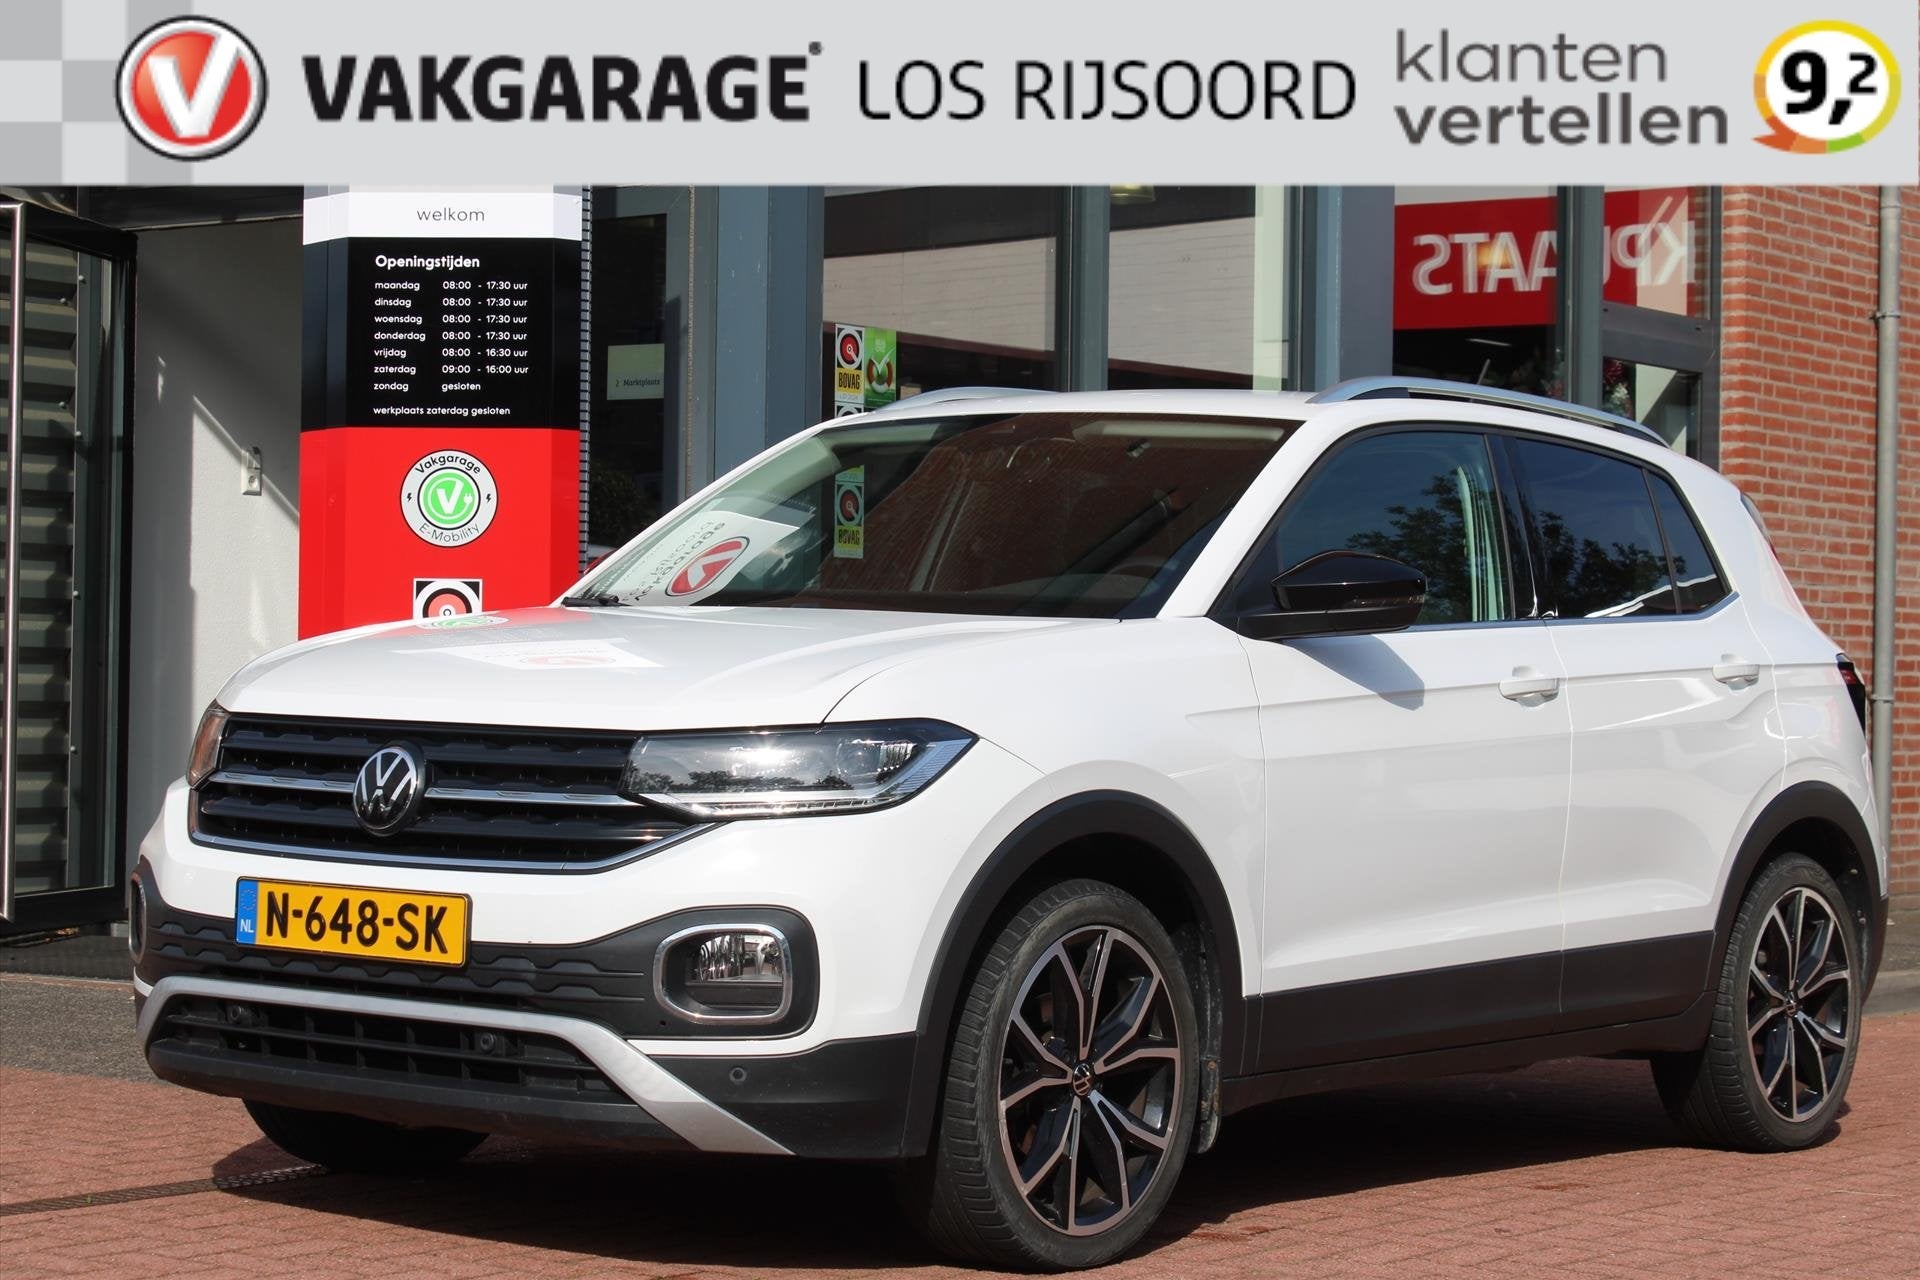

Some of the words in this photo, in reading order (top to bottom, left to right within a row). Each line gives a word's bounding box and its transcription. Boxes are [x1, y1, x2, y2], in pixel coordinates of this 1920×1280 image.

[416, 207, 485, 222] welkom
[375, 254, 480, 271] Openingstijden
[374, 281, 420, 291] maandag
[443, 281, 471, 290] 08:00
[486, 281, 511, 290] 17:30
[374, 297, 411, 308] dinsdag
[443, 297, 471, 306] 08:00
[486, 297, 511, 306] 17:30
[374, 315, 422, 325] woensdag
[442, 315, 471, 324] 08:00
[486, 315, 511, 324] 17:30
[374, 331, 426, 342] donderdag
[442, 331, 471, 340] 08:00
[486, 331, 511, 340] 17:30
[374, 348, 407, 359] vrijdag
[442, 348, 471, 357] 08:00
[486, 348, 511, 357] 16:30
[374, 365, 416, 375] zaterdag
[442, 365, 471, 374] 09:00
[486, 365, 511, 374] 16:00
[374, 382, 409, 392] zondag
[441, 382, 481, 392] gesloten
[838, 373, 861, 390] BOVAG
[373, 406, 425, 416] werkplaats
[426, 406, 469, 416] zaterdag
[471, 406, 511, 416] gesloten
[415, 455, 481, 474] Vakgarage
[419, 522, 480, 543] E-Mobility
[838, 529, 860, 546] BOVAG
[240, 918, 255, 934] NL
[266, 891, 448, 954] N-648-SK
